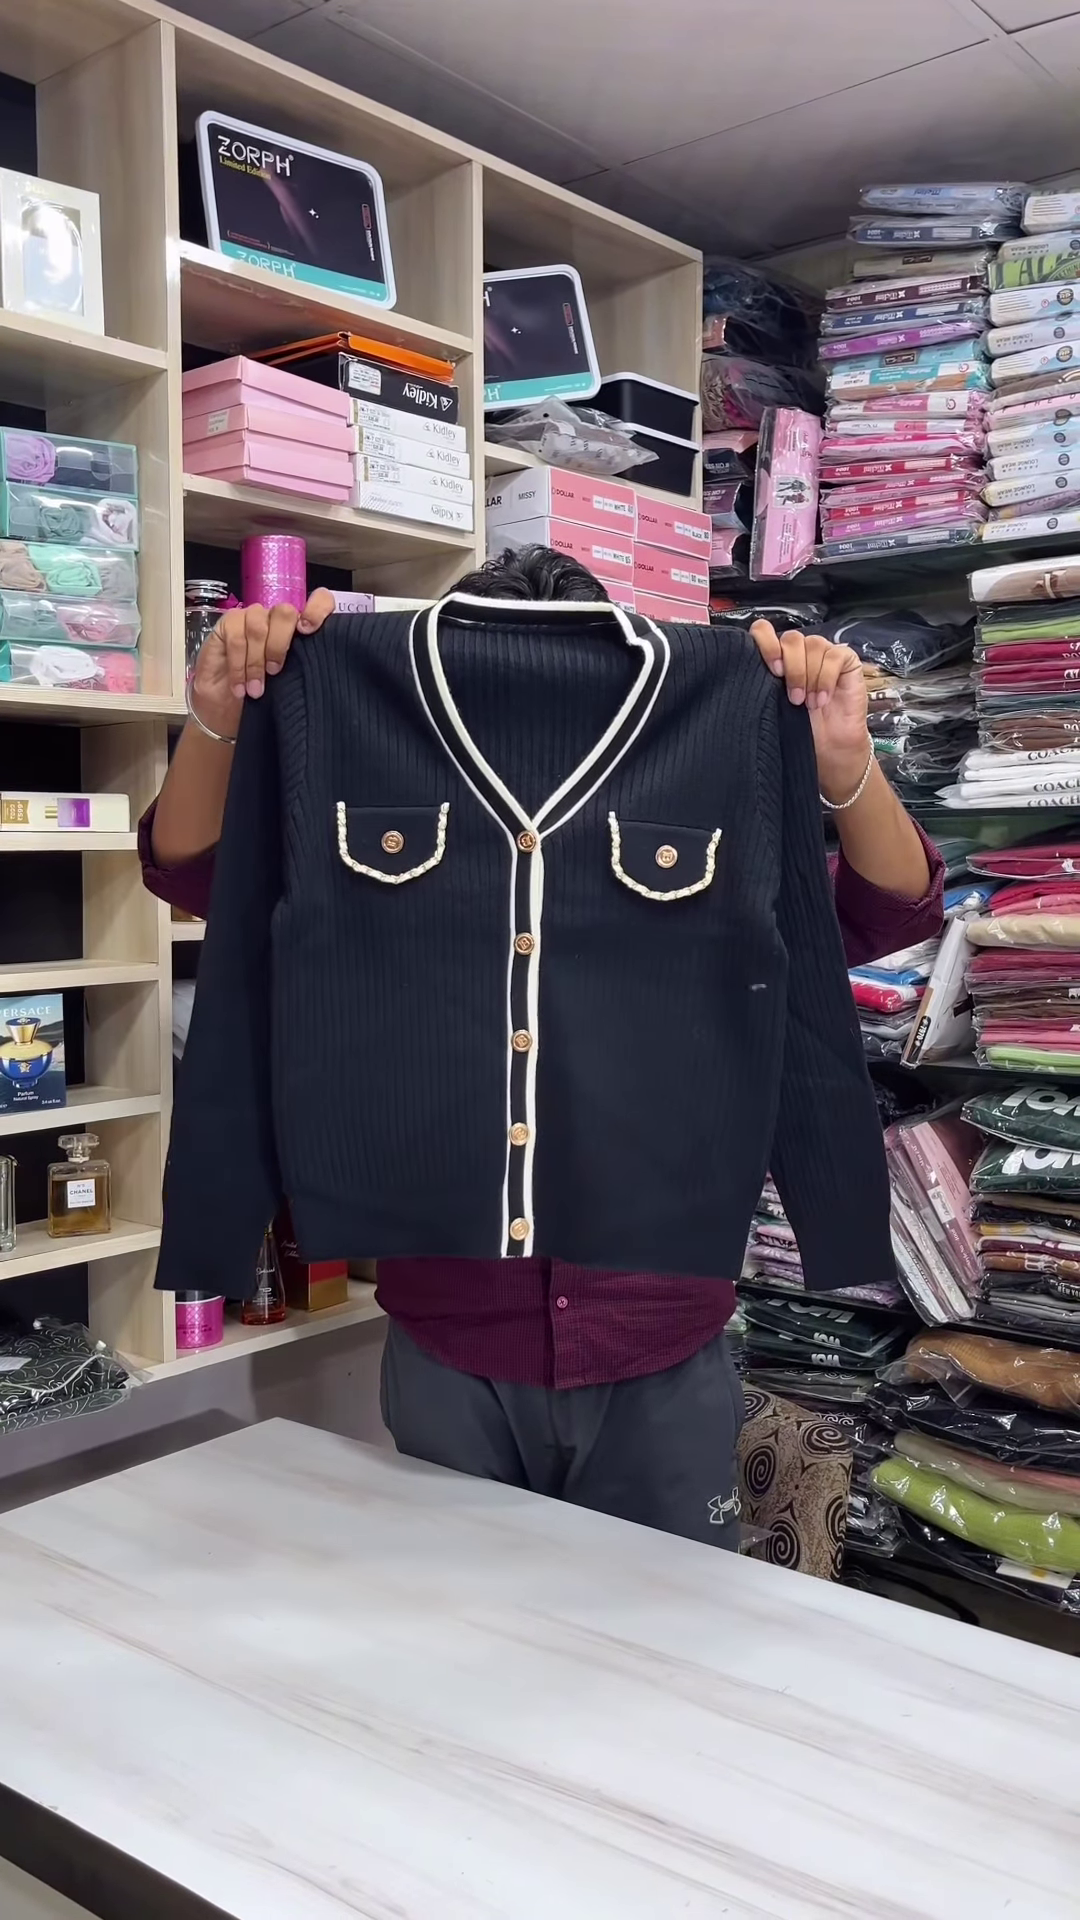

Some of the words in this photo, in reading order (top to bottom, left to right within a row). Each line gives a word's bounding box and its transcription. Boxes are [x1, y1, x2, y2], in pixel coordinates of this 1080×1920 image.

[217, 135, 291, 177] ZORPH
[402, 383, 438, 409] Kidley
[432, 422, 457, 441] Kidley
[436, 449, 461, 467] Kidley
[440, 477, 464, 494] Kidley
[556, 488, 575, 499] DOLLAR
[485, 495, 502, 508] LAR
[518, 490, 537, 501] MISSY
[430, 504, 455, 521] Kidley
[641, 515, 658, 524] DOLLAR
[554, 540, 574, 550] DOLLAR
[636, 562, 655, 572] DOLLAR
[338, 602, 369, 614] UCCI
